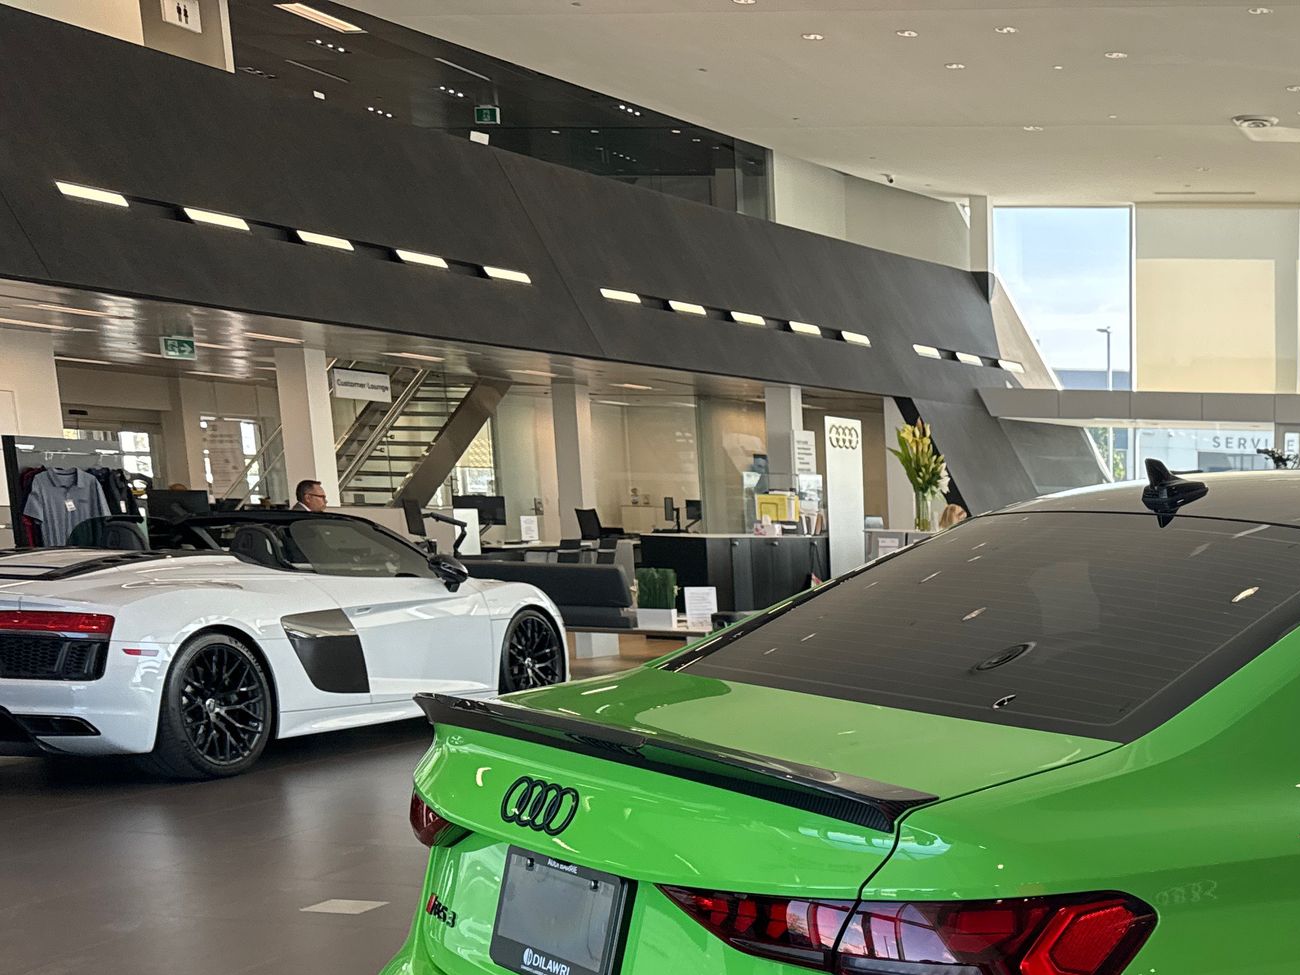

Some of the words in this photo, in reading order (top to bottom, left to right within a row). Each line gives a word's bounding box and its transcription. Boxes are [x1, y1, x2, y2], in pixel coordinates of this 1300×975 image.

[336, 378, 366, 389] Customer
[366, 382, 389, 392] Lounge
[1212, 436, 1296, 453] SERVIE
